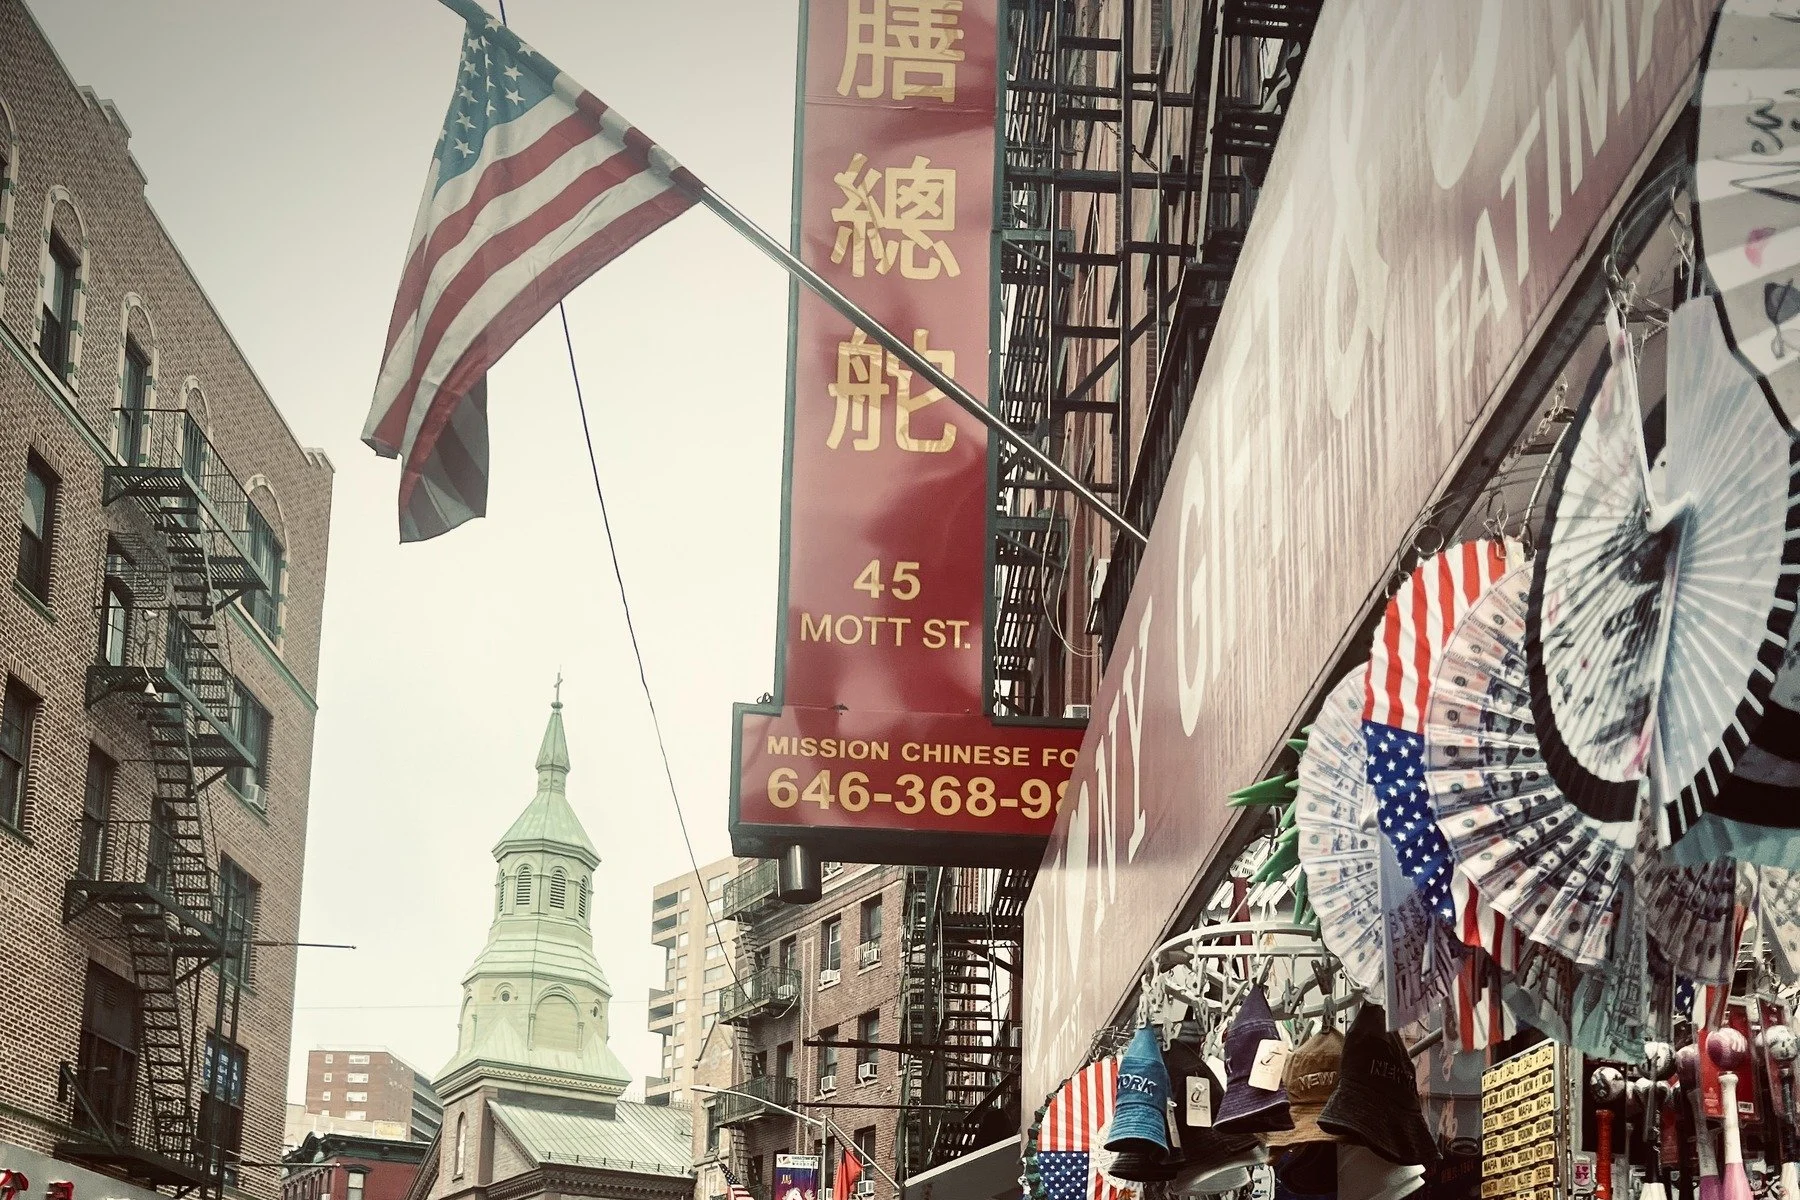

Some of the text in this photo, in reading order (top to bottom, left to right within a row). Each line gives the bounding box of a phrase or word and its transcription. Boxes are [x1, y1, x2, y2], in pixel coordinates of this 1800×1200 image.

[853, 559, 922, 601] 45
[800, 613, 971, 649] MOTT ST.
[766, 736, 890, 761] MISSION
[901, 742, 1030, 766] CHINESE
[1094, 594, 1153, 936] NY
[1298, 1071, 1338, 1091] NEW
